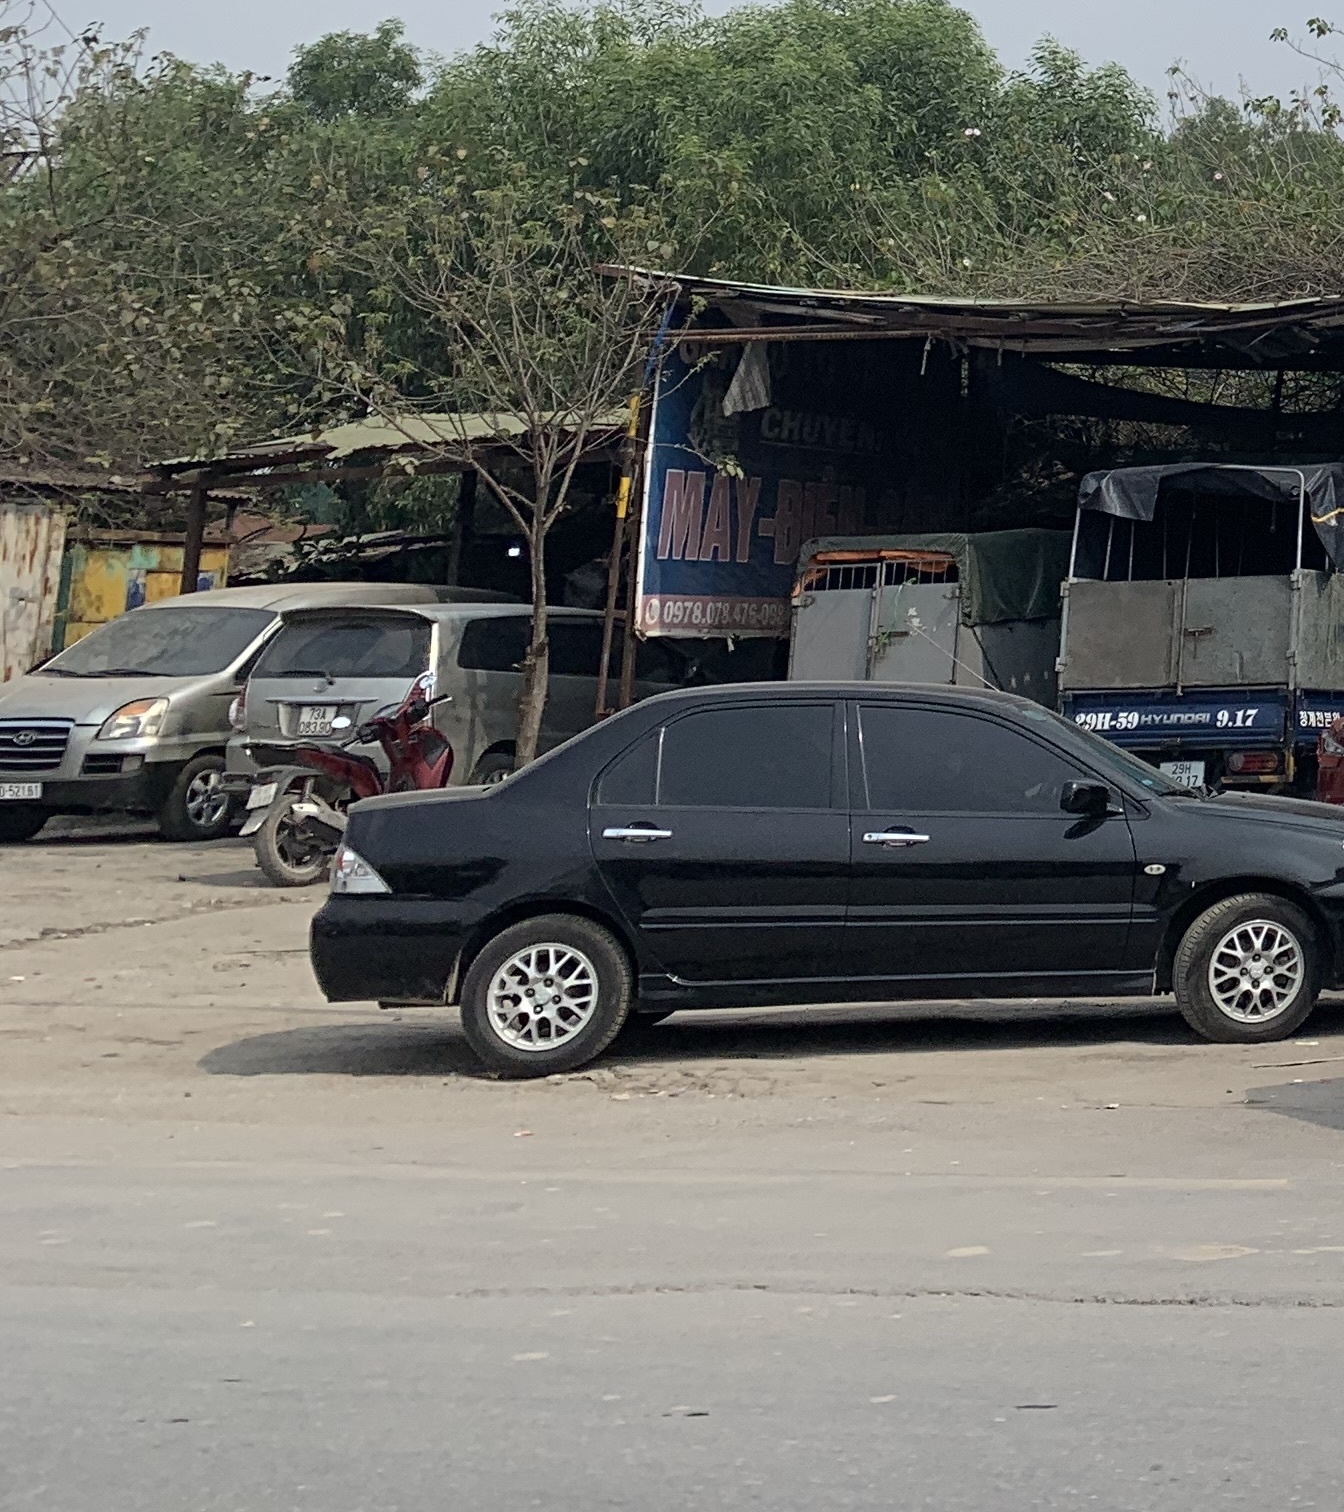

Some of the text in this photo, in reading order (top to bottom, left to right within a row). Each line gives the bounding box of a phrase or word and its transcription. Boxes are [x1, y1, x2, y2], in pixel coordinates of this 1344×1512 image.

[1075, 709, 1258, 730] 29H-59 HYUNDAI 9.17
[1172, 763, 1191, 775] 29H
